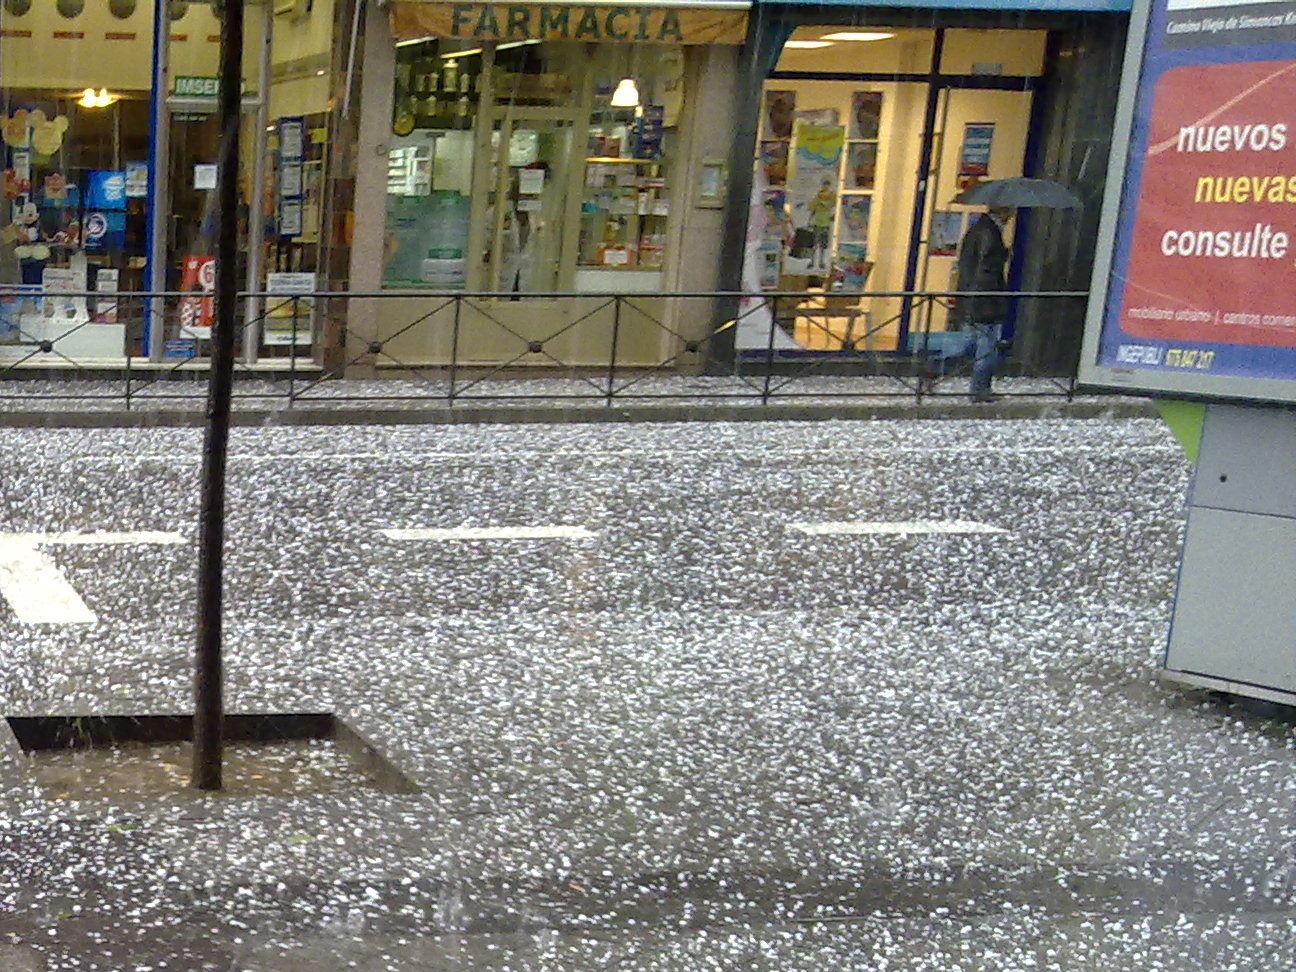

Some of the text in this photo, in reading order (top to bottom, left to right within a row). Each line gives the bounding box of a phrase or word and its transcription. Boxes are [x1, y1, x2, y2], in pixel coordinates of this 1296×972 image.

[451, 4, 684, 42] FARMACIA
[1177, 123, 1287, 153] nuevos
[1194, 175, 1296, 203] nuevas
[1160, 222, 1289, 259] consulte
[1127, 306, 1174, 321] mobiliario
[1174, 308, 1211, 322] urbano
[1223, 311, 1261, 325] centros
